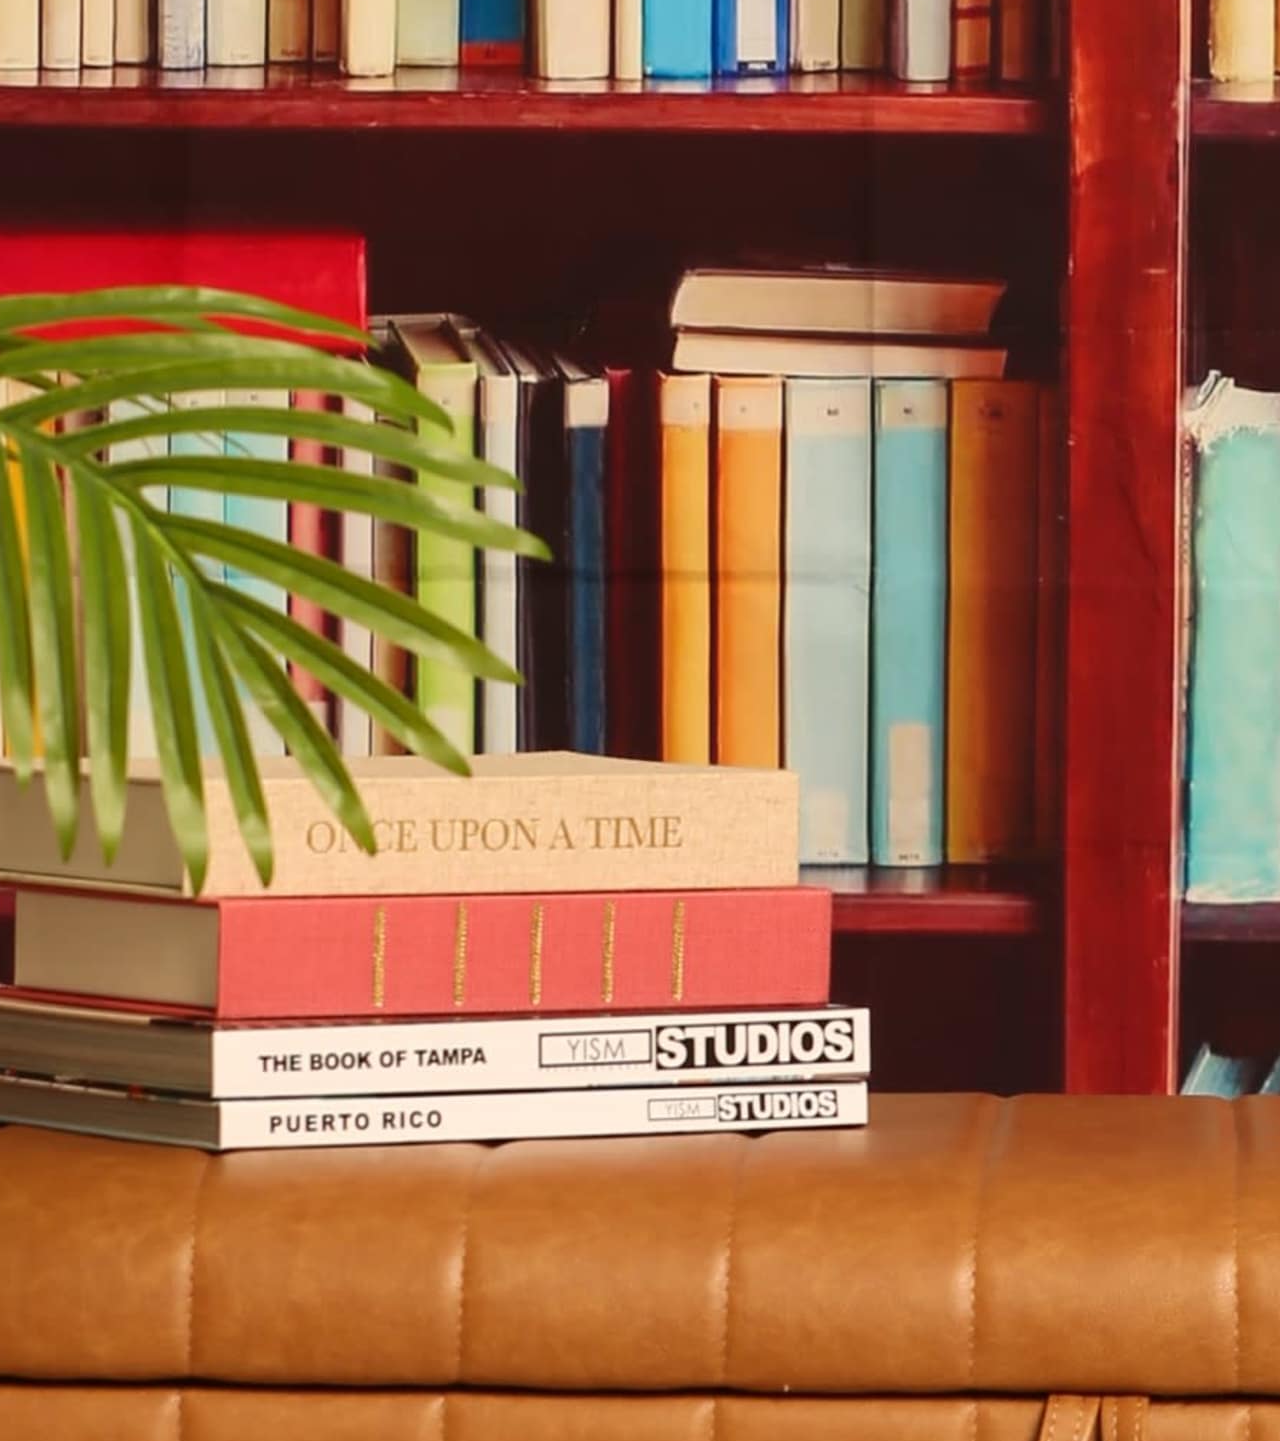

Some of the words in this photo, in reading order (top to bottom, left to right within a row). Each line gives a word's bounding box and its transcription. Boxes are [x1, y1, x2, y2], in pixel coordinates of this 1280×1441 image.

[430, 818, 538, 851] UPON
[549, 819, 574, 850] A
[586, 816, 683, 849] TIME
[259, 1054, 302, 1072] THE
[310, 1051, 373, 1070] BOOK
[379, 1051, 407, 1068] OF
[414, 1047, 487, 1067] TAMPA
[567, 1037, 626, 1061] YISM
[657, 1018, 854, 1070] STUDIOS
[718, 1090, 838, 1121] STUDIOS
[269, 1113, 370, 1133] PUERTO
[382, 1110, 443, 1130] RICO
